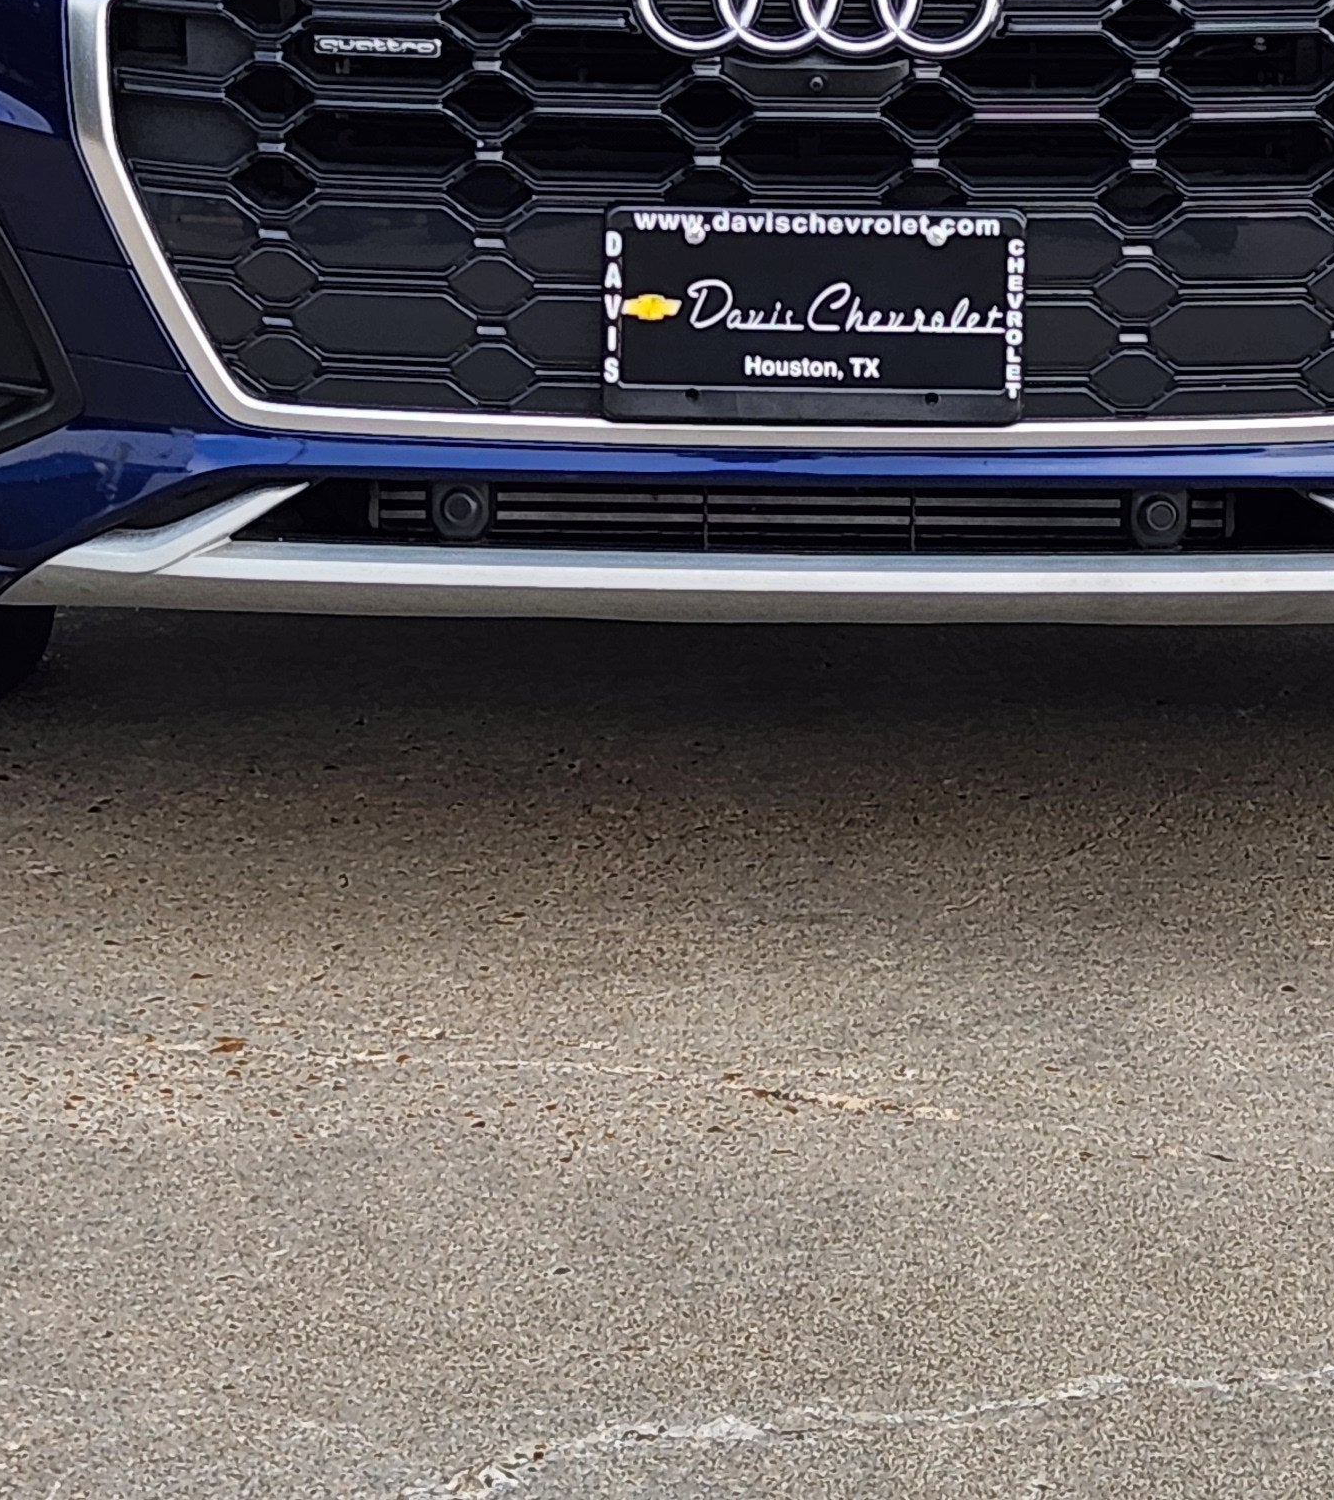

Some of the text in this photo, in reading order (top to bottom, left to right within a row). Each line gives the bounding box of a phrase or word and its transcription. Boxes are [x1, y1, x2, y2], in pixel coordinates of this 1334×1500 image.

[319, 38, 435, 54] quattro
[634, 211, 1000, 236] www.davischevroletcom
[603, 230, 623, 384] DAVIS
[686, 278, 1005, 334] Davis Chevrolet
[1004, 238, 1025, 400] CHEVROLET
[744, 355, 880, 380] Houston, TX
